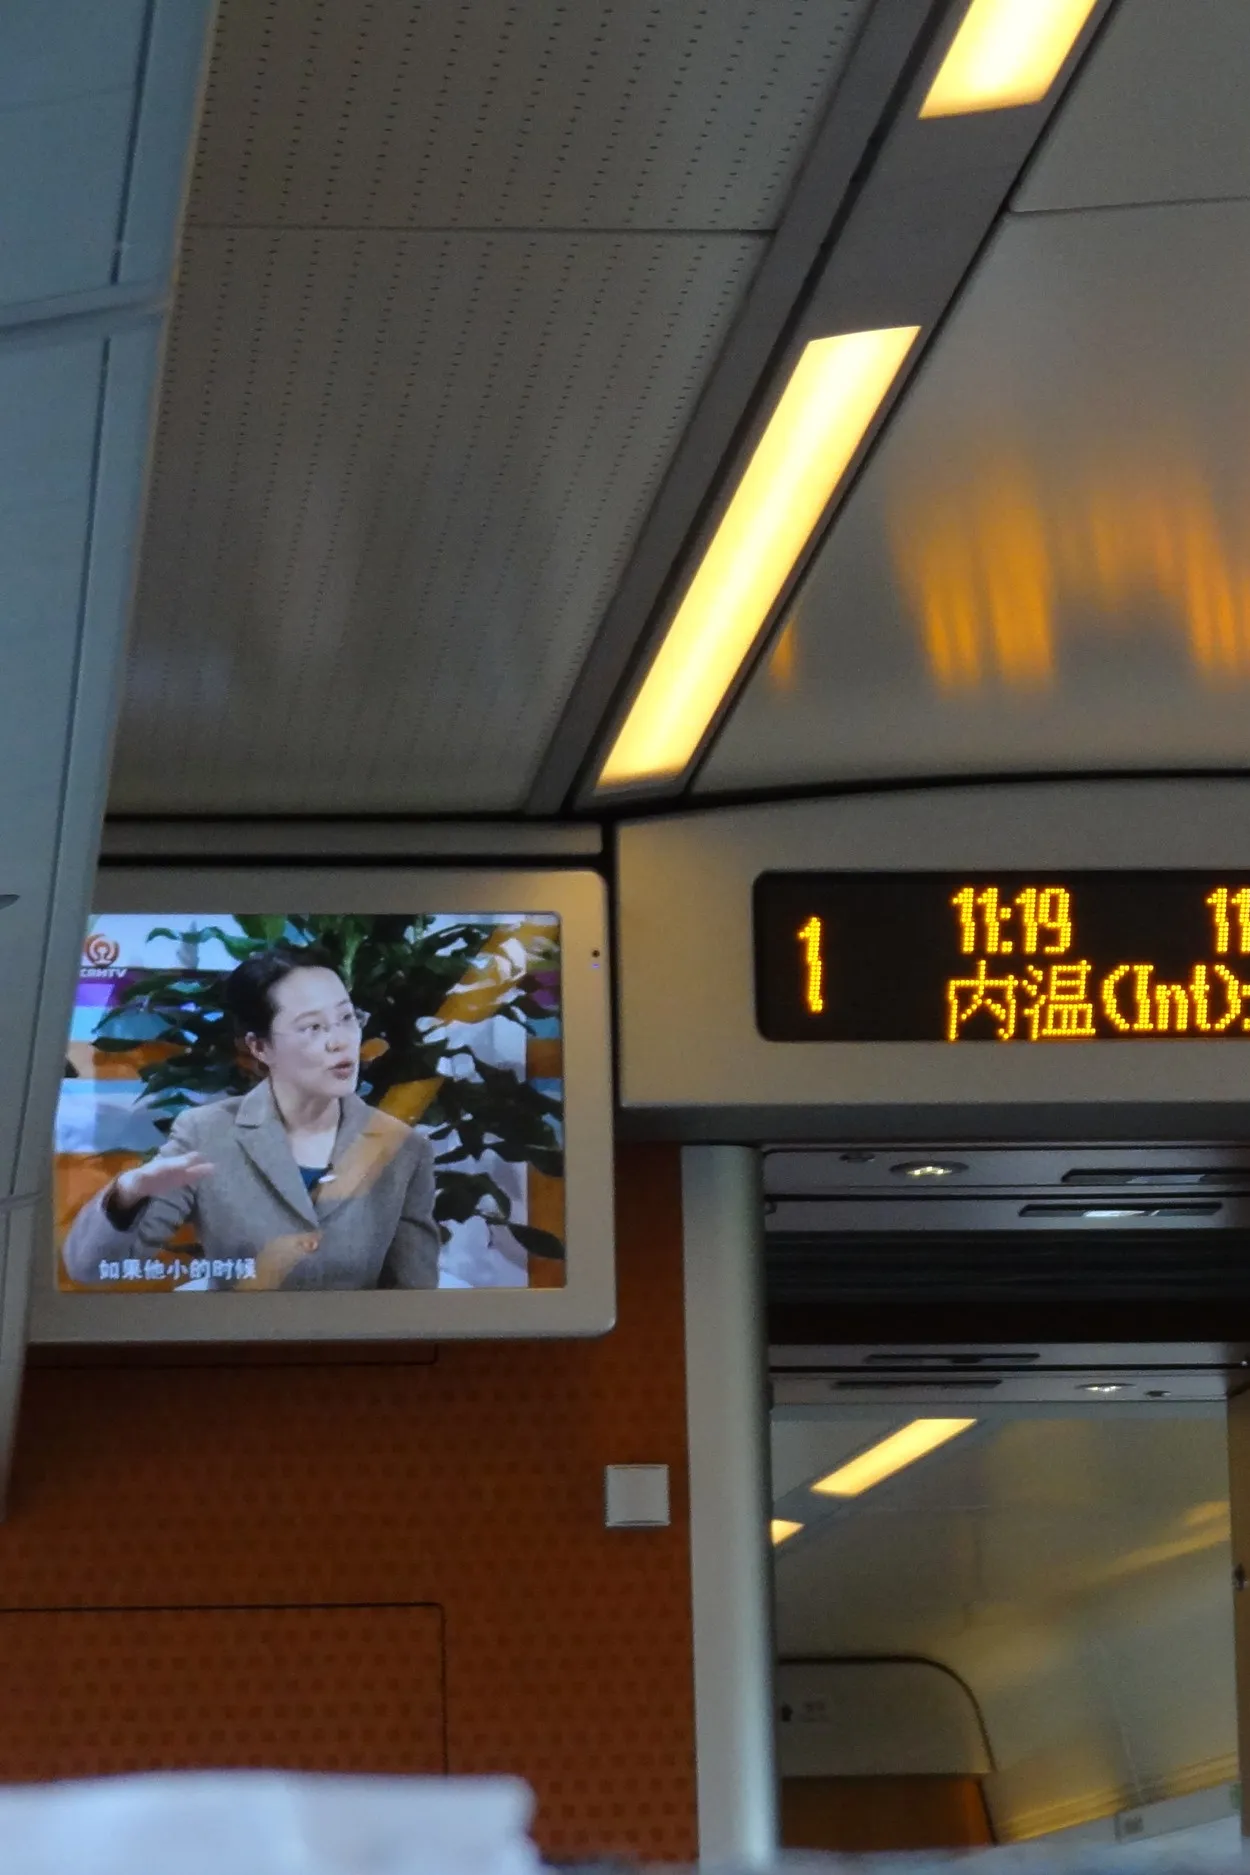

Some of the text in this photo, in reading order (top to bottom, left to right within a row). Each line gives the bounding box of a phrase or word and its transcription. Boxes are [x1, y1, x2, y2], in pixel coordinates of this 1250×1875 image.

[951, 886, 1072, 953] 11:19
[797, 916, 823, 1013] 1
[99, 1258, 257, 1280] 如果他小的时候
